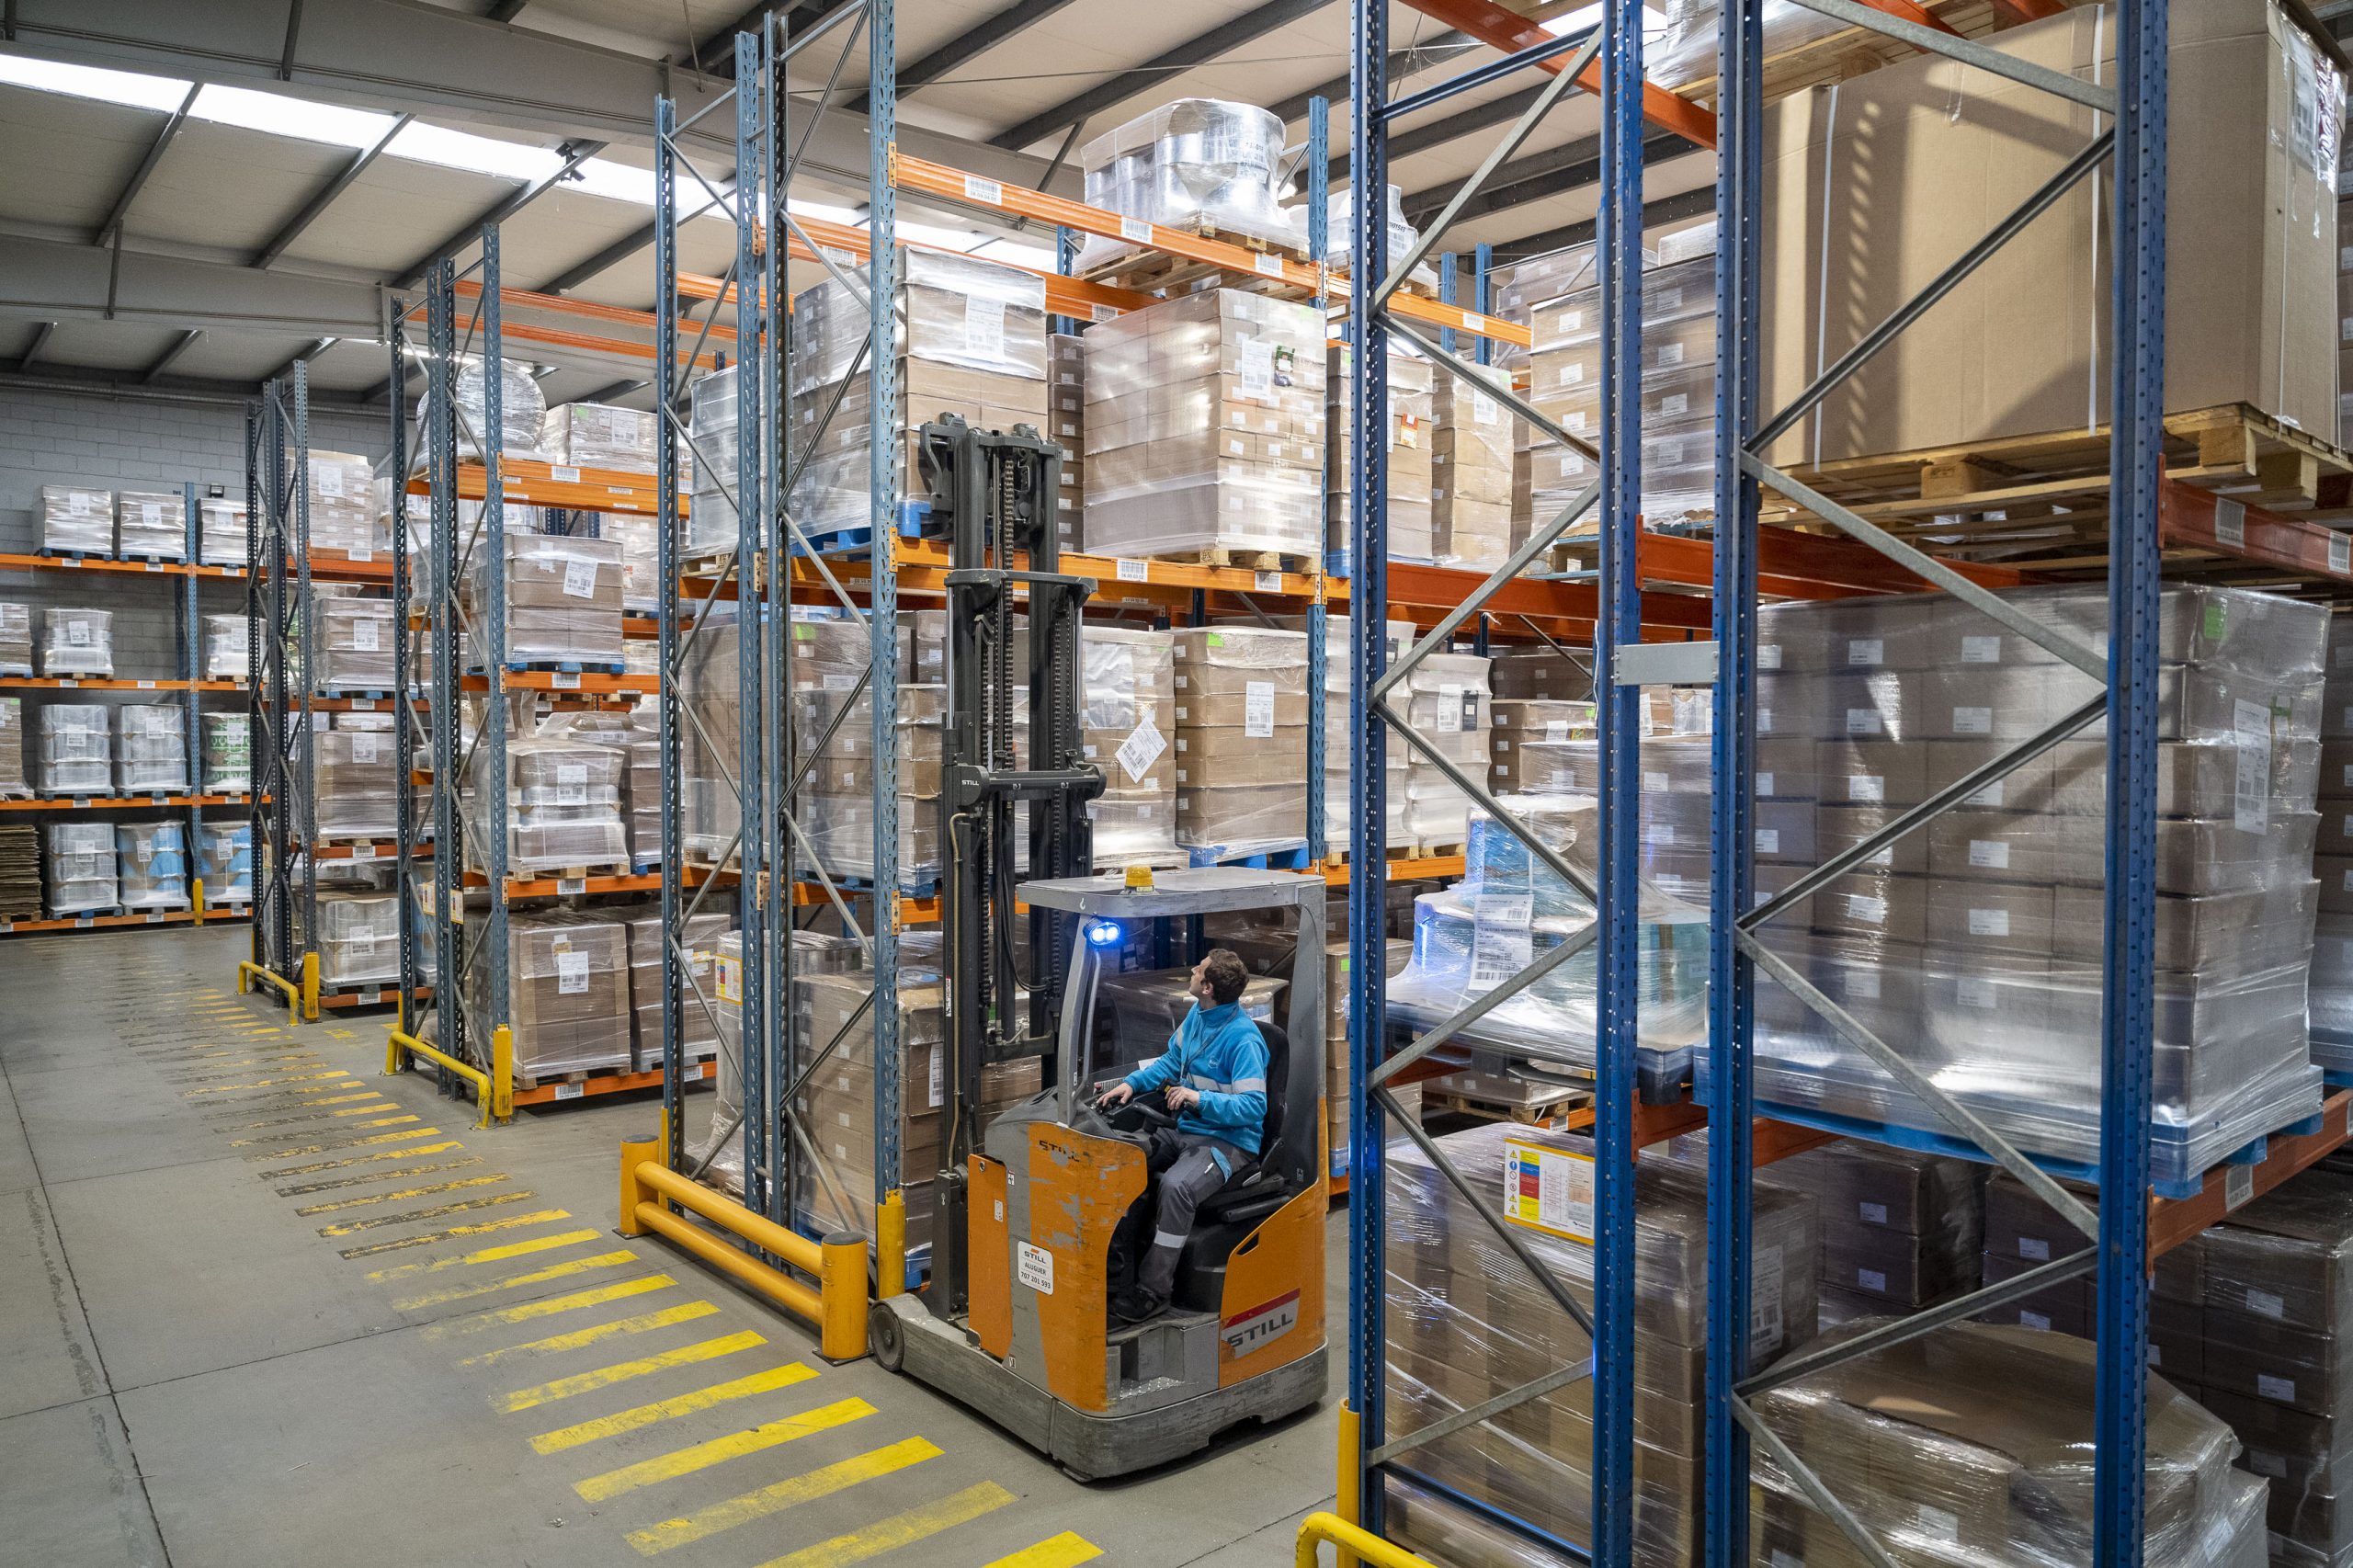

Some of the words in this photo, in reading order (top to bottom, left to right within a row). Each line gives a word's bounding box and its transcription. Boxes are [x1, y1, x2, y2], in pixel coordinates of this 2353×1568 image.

[1024, 1250, 1046, 1264] STILL
[1025, 1262, 1047, 1276] ALUGUER
[1020, 1271, 1030, 1280] 707
[1030, 1276, 1040, 1285] 201
[1041, 1279, 1051, 1289] 593
[1227, 1313, 1293, 1347] STILL
